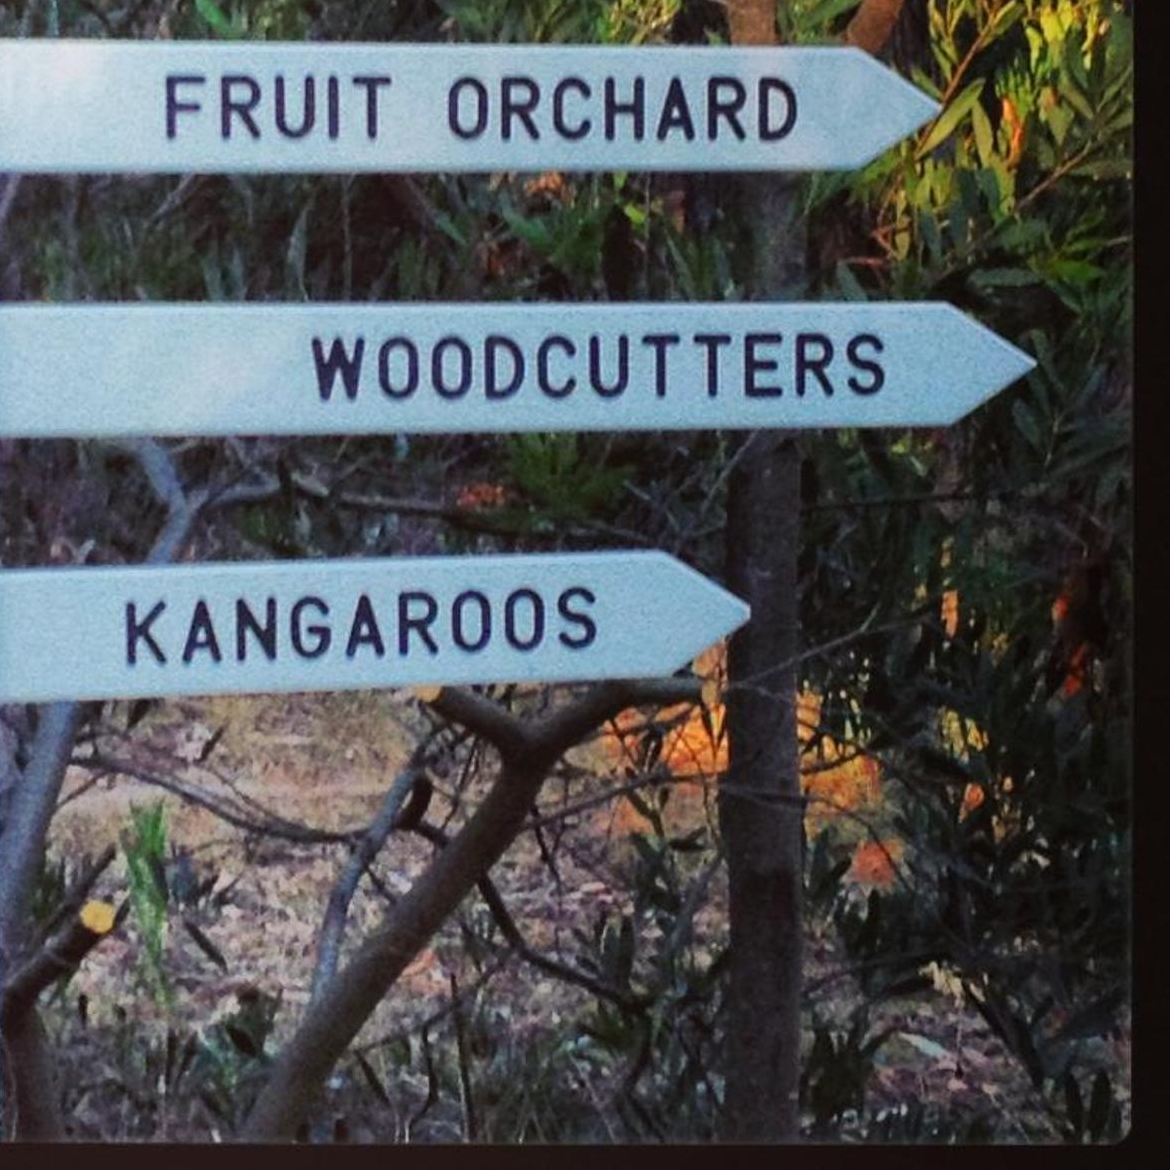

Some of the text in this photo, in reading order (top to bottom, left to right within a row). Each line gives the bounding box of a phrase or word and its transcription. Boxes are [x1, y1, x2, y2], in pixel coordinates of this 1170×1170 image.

[166, 75, 797, 141] FRUIT ORCHARD
[312, 333, 884, 400] WOODCUTTERS
[126, 587, 596, 665] KANGAROOS
